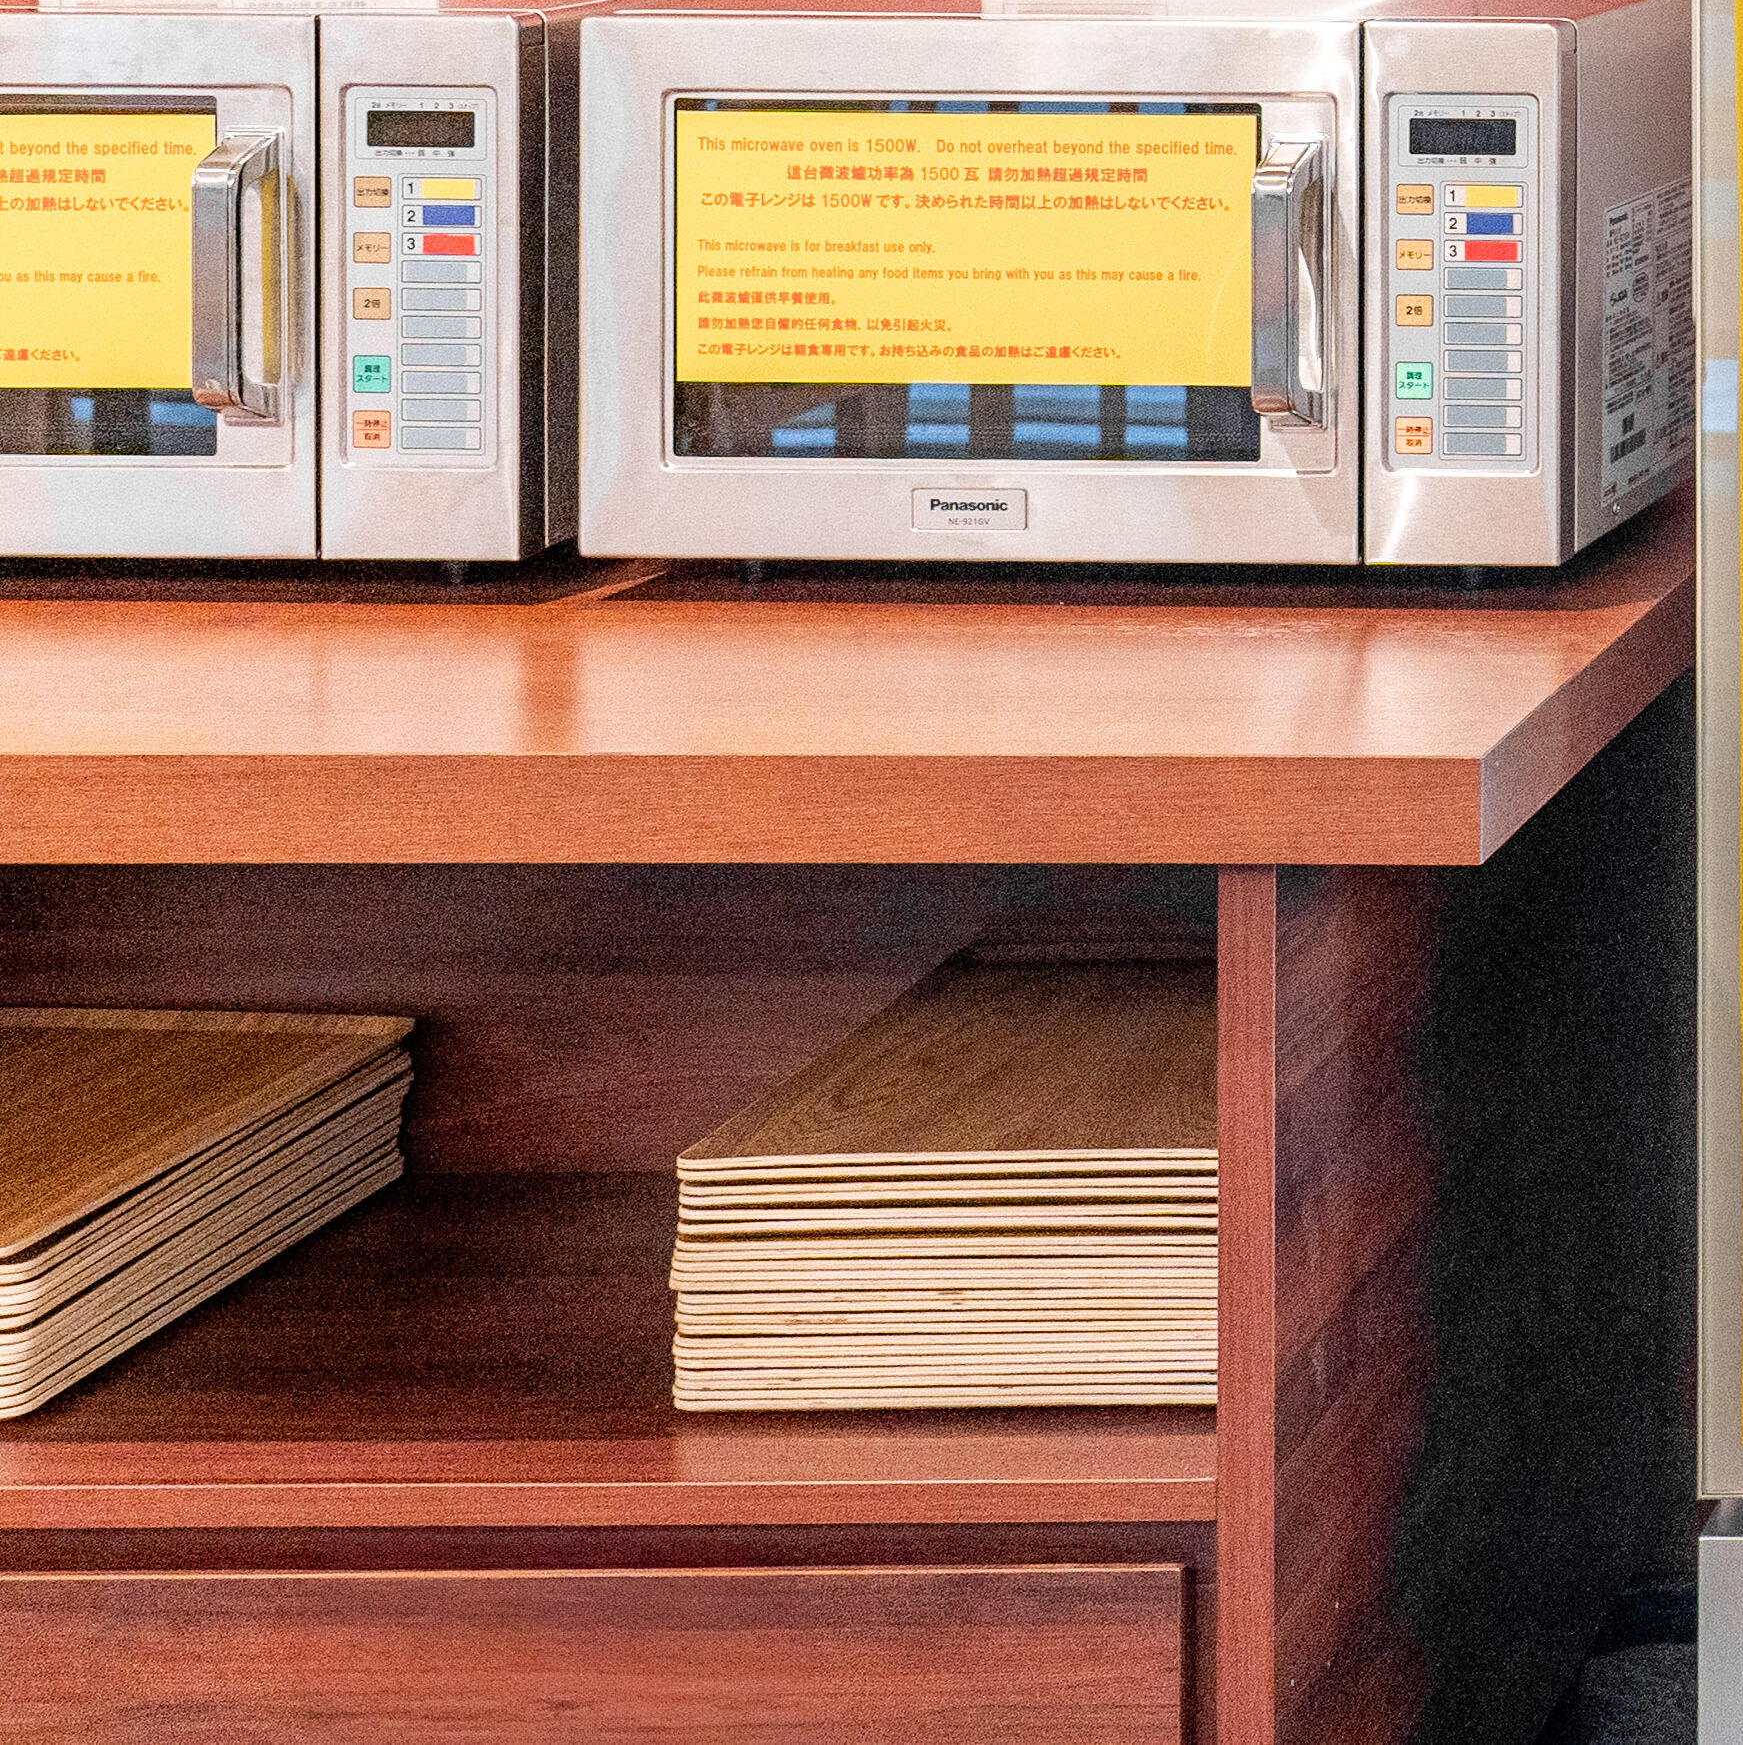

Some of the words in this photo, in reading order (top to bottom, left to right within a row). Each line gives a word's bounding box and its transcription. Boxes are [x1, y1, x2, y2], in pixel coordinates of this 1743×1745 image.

[9, 140, 61, 157] beyond
[65, 140, 89, 156] the
[93, 140, 159, 157] specified
[163, 140, 197, 156] time.
[697, 135, 726, 152] This
[730, 137, 805, 152] microwave
[808, 140, 843, 153] oven
[847, 138, 860, 153] is
[865, 137, 922, 154] 1500W.
[935, 138, 955, 154] Do
[959, 139, 983, 154] not
[986, 139, 1048, 155] overheat
[1052, 139, 1104, 156] beyond
[1108, 140, 1131, 155] the
[1135, 140, 1200, 157] specified
[1203, 141, 1238, 156] time.
[700, 191, 816, 209] この電子レンジは
[822, 193, 872, 209] 1500W
[1449, 217, 1458, 230] 2
[697, 238, 722, 252] This
[724, 239, 787, 253] microwave
[790, 240, 801, 253] is
[804, 239, 821, 253] for
[824, 240, 880, 253] breakfast
[883, 242, 905, 254] use
[908, 240, 937, 255] only.
[1449, 244, 1458, 257] 3
[929, 498, 1009, 512] Panasonic
